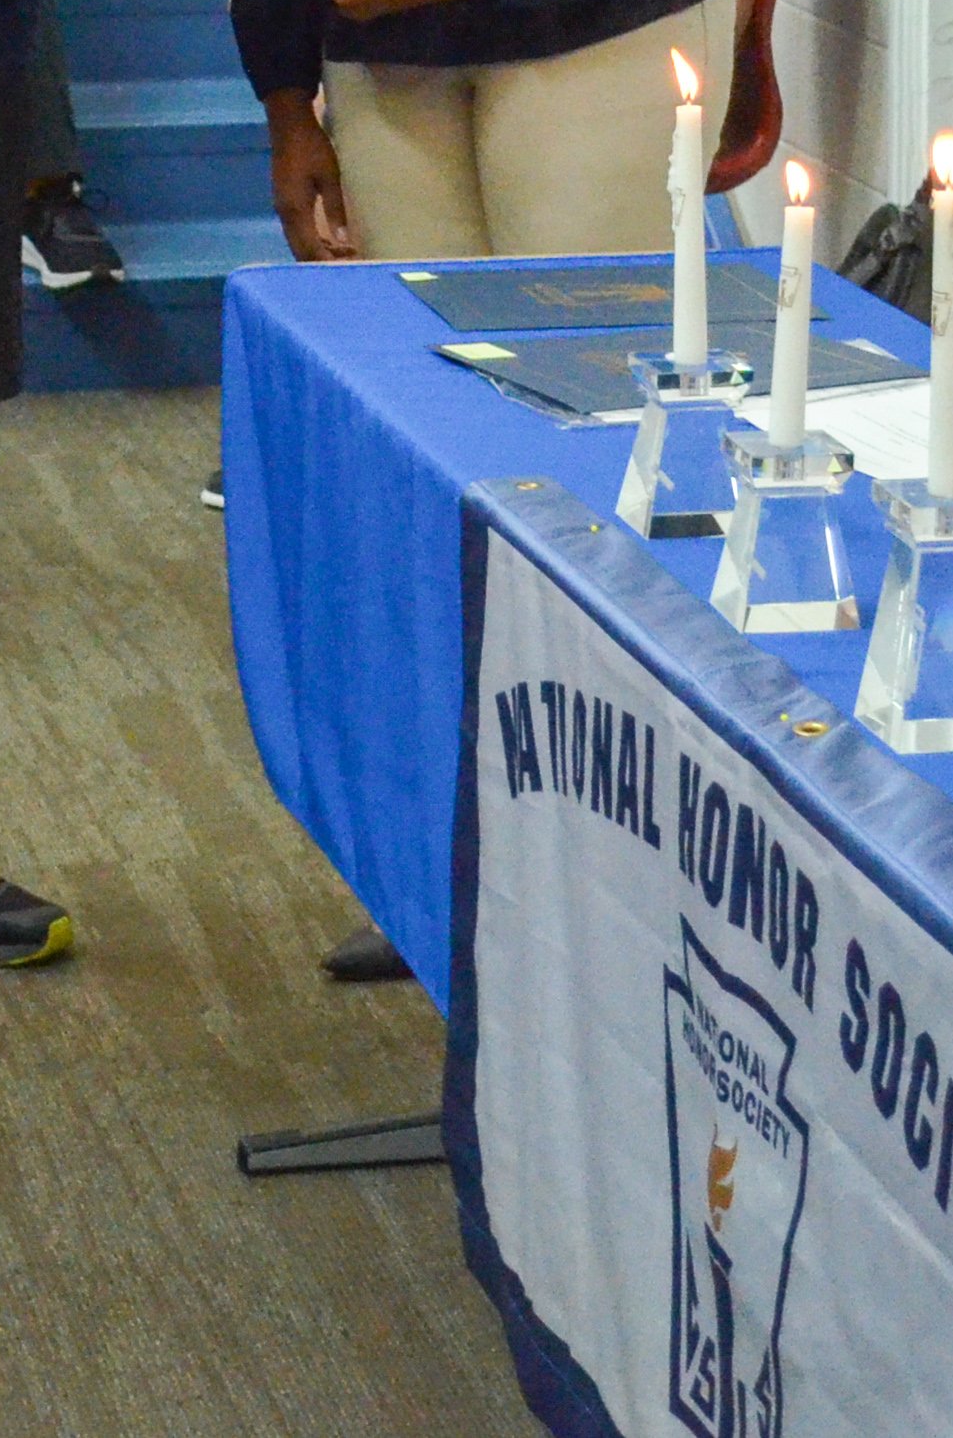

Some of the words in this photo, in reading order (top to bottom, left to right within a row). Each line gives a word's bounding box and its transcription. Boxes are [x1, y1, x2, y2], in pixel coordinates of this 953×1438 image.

[495, 679, 661, 851] NATIONAL
[678, 752, 821, 1013] HONOR
[716, 1068, 791, 1160] SOCIETY
